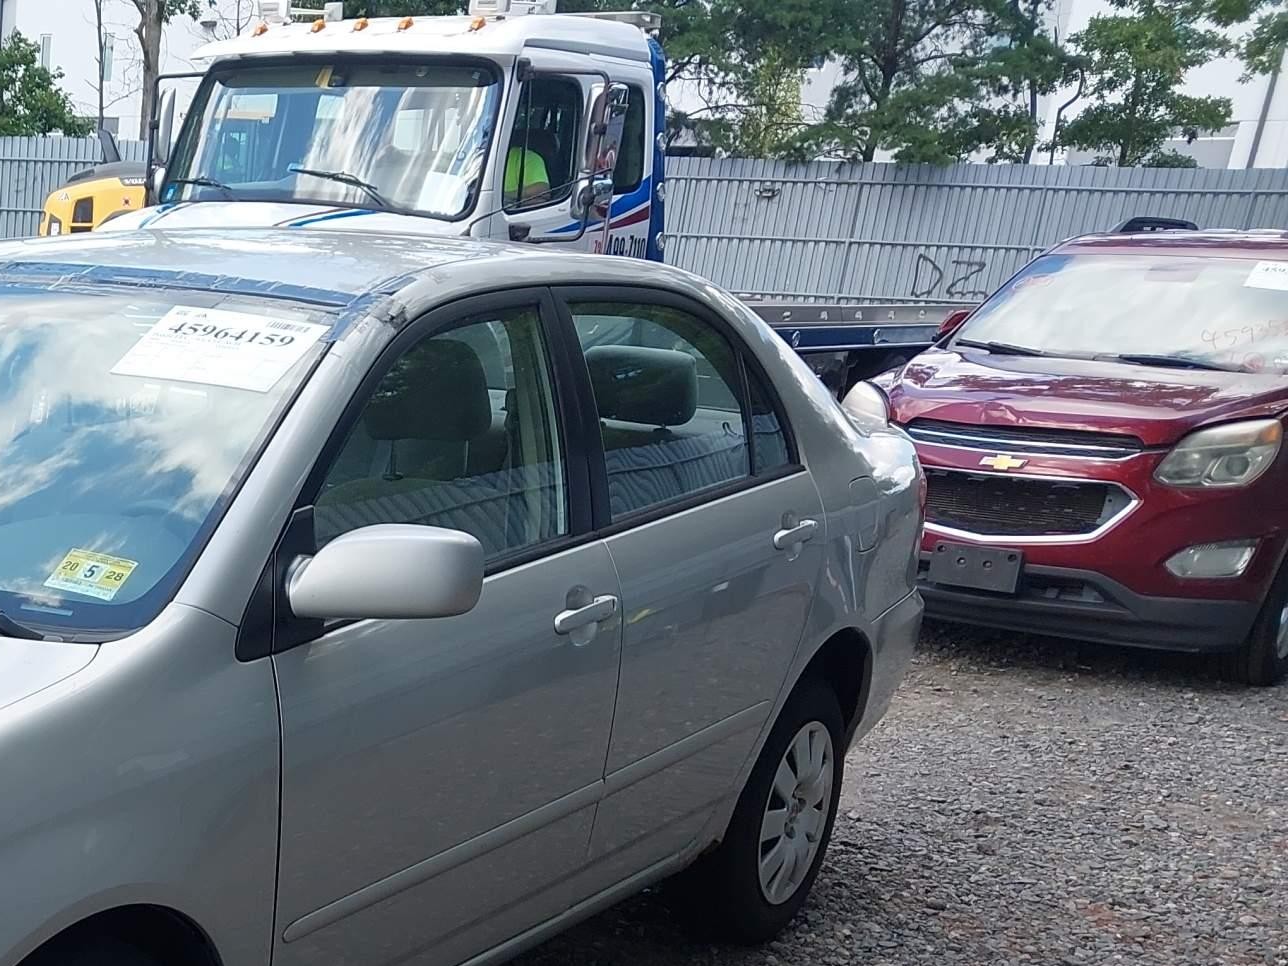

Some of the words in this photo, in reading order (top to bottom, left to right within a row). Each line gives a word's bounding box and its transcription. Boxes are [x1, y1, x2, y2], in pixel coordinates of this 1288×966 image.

[167, 321, 296, 348] 45964159
[62, 560, 79, 571] 20
[83, 564, 99, 578] 5
[105, 570, 124, 581] 28
